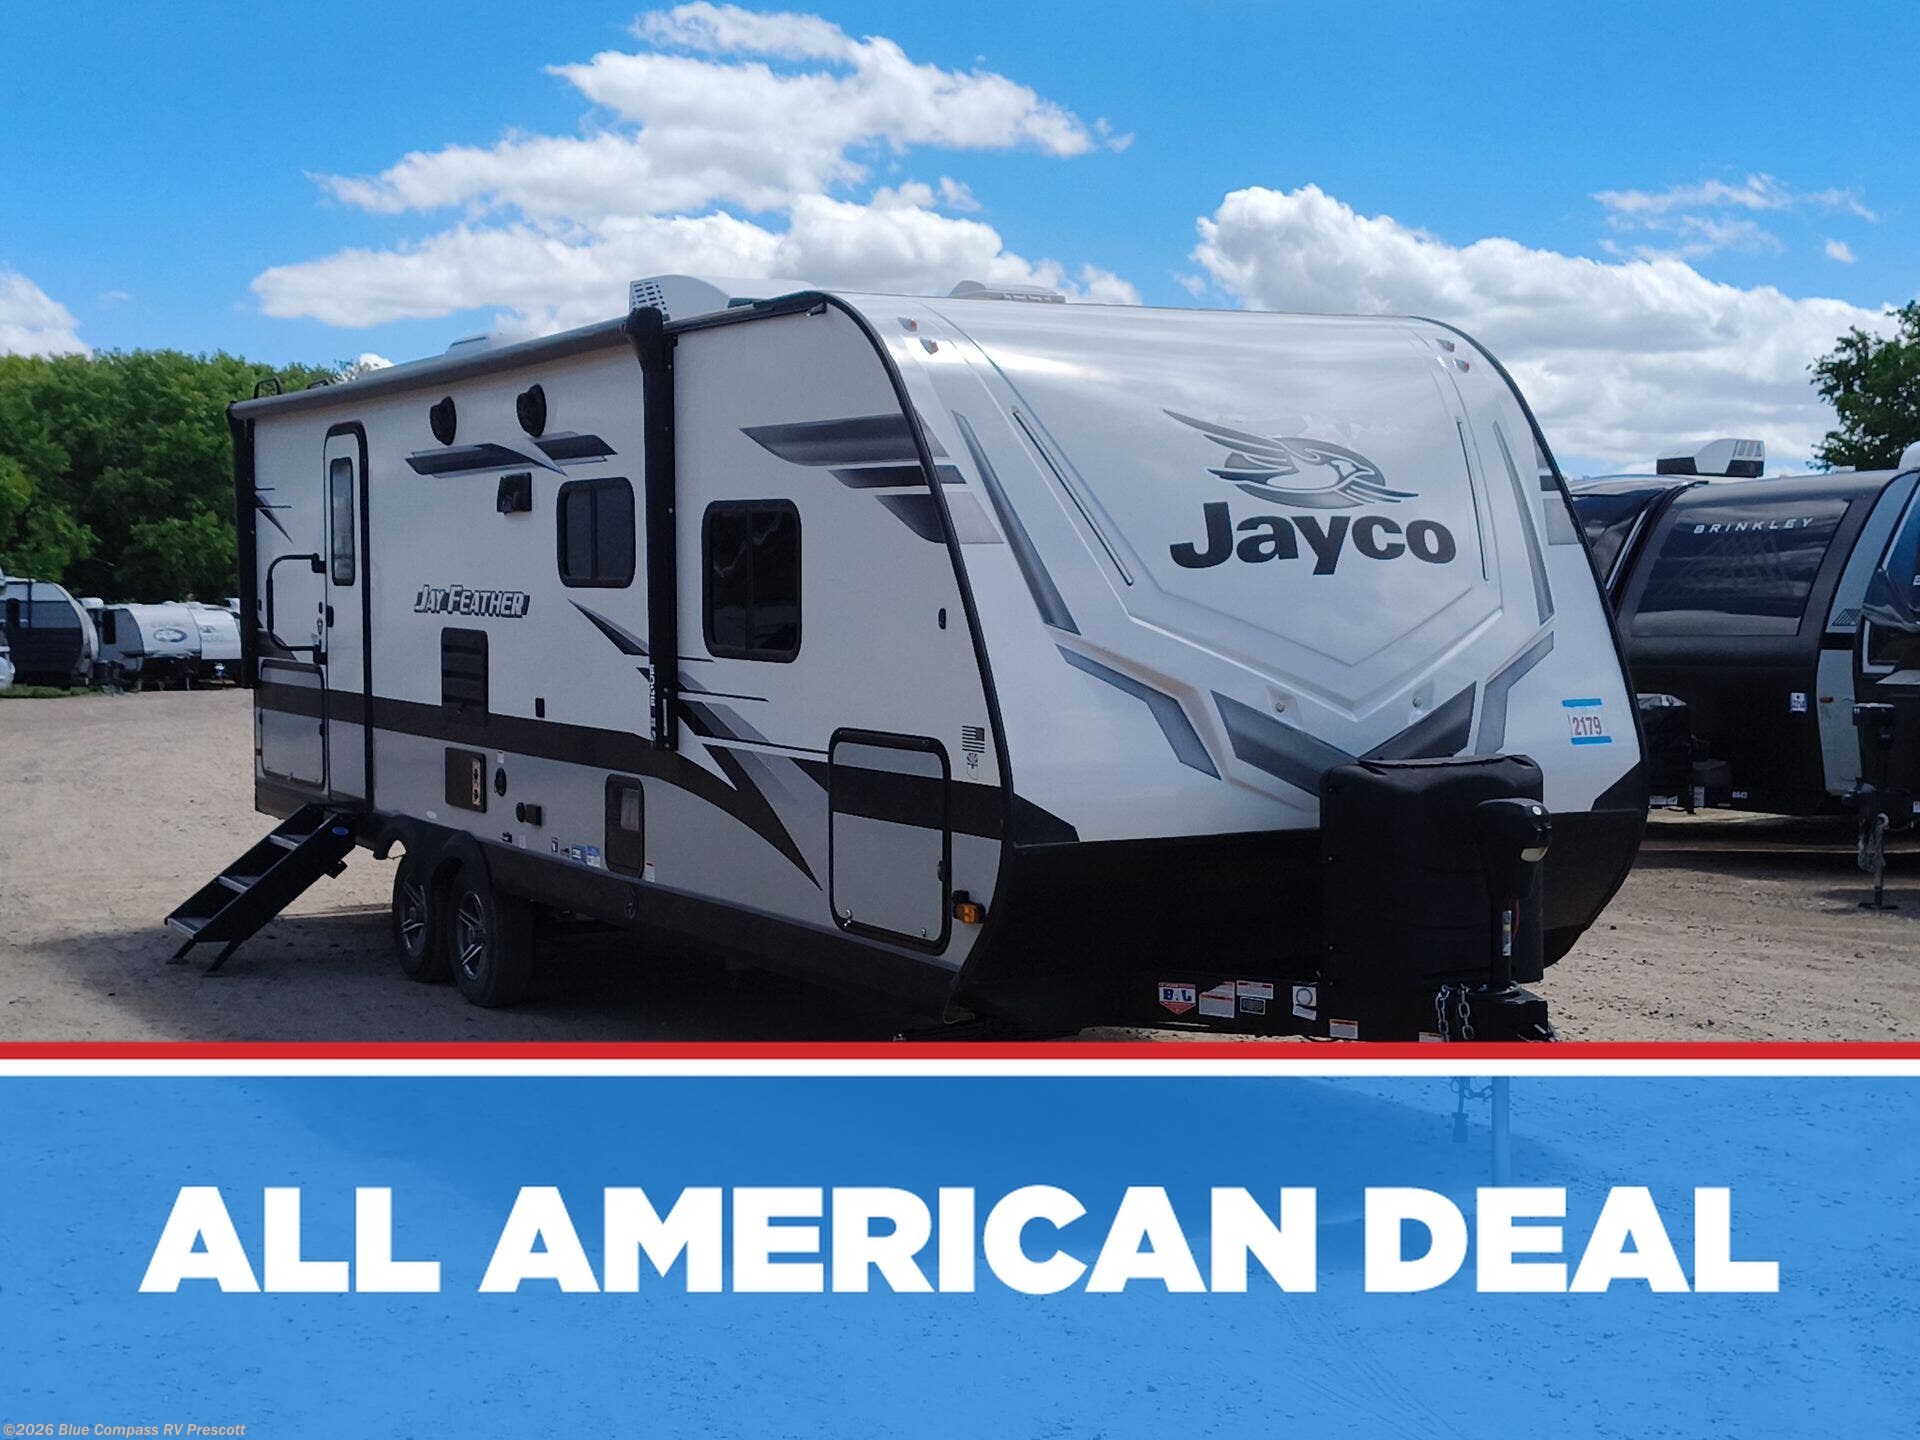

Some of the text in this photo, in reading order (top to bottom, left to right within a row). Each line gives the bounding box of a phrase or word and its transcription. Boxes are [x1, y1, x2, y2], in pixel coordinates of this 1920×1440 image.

[1170, 501, 1457, 575] Jayco
[1693, 518, 1814, 534] BRINKLEY
[447, 584, 531, 618] FEATHER
[1572, 716, 1602, 735] 2179
